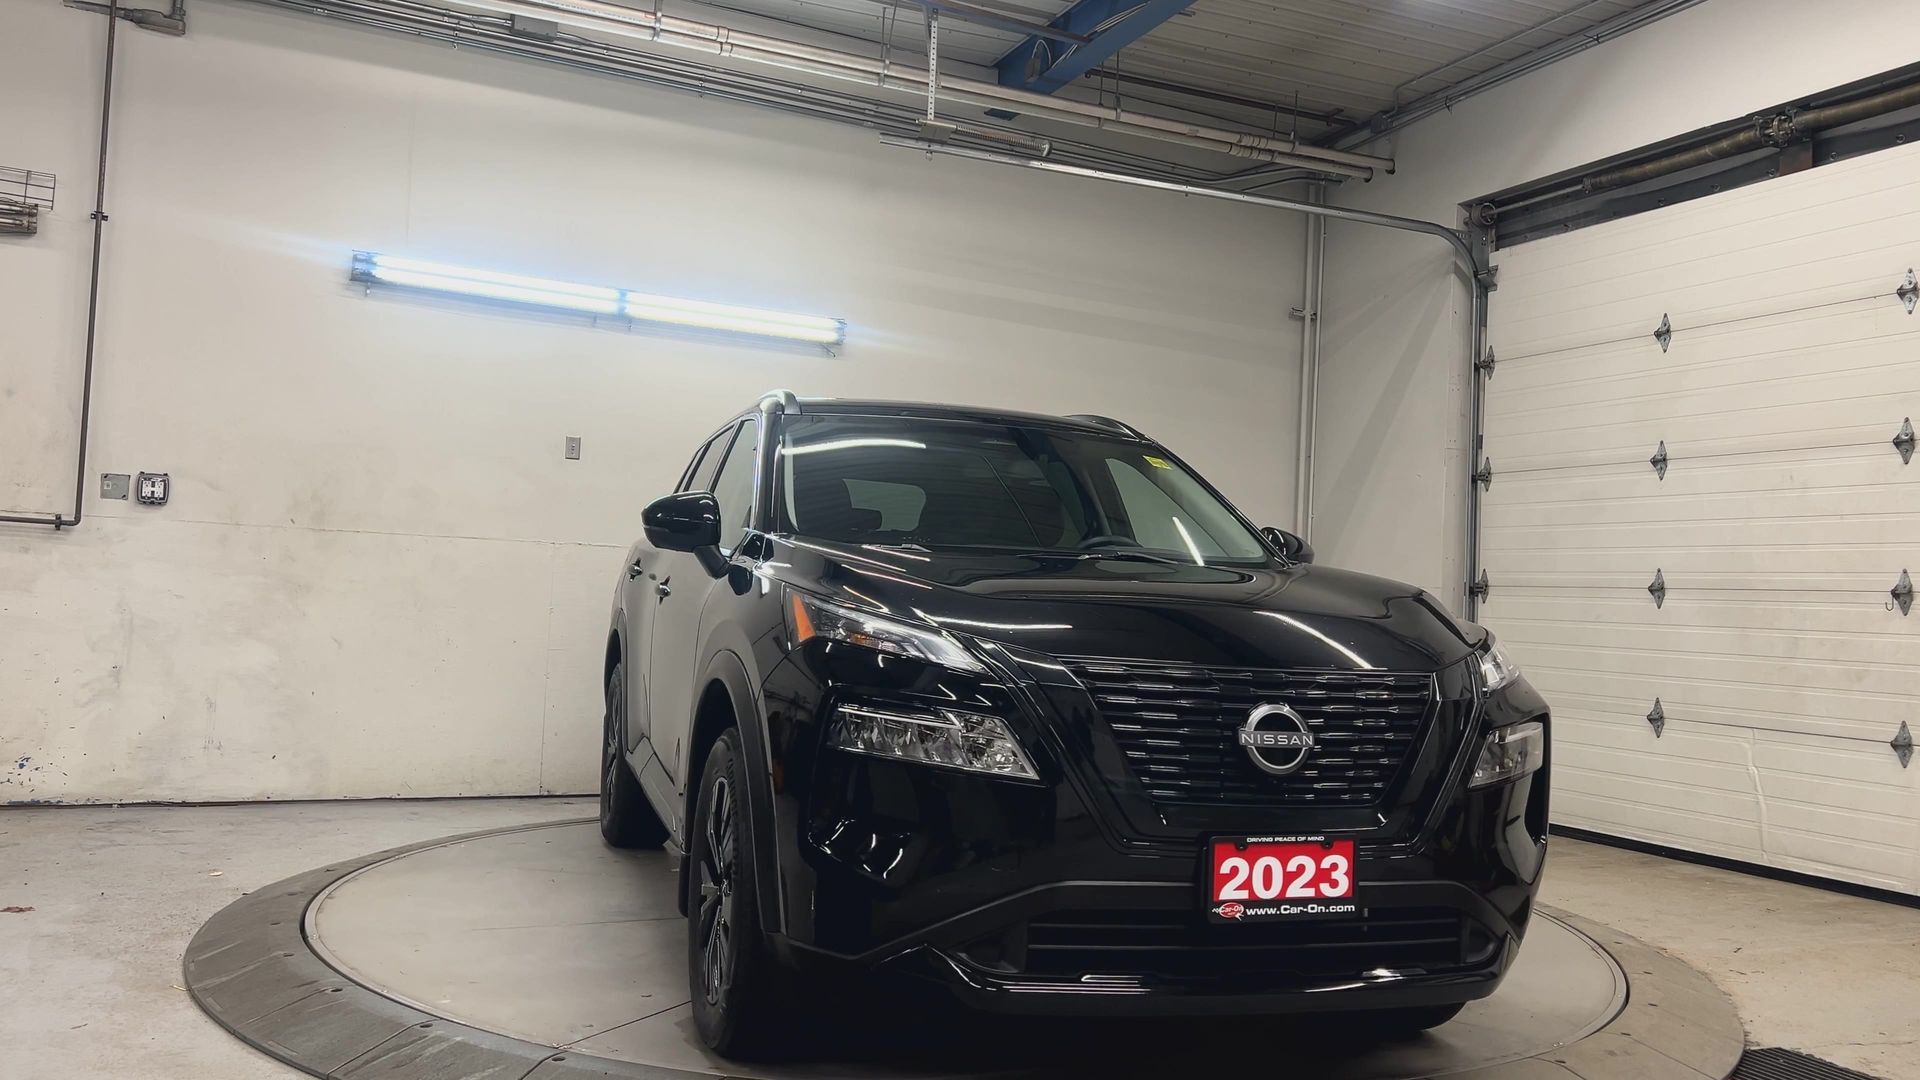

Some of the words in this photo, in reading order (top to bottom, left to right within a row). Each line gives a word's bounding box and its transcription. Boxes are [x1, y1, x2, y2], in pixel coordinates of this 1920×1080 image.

[1241, 733, 1313, 745] NISSAN
[1218, 854, 1350, 900] 2023
[1246, 904, 1355, 915] www.Car-On.com
